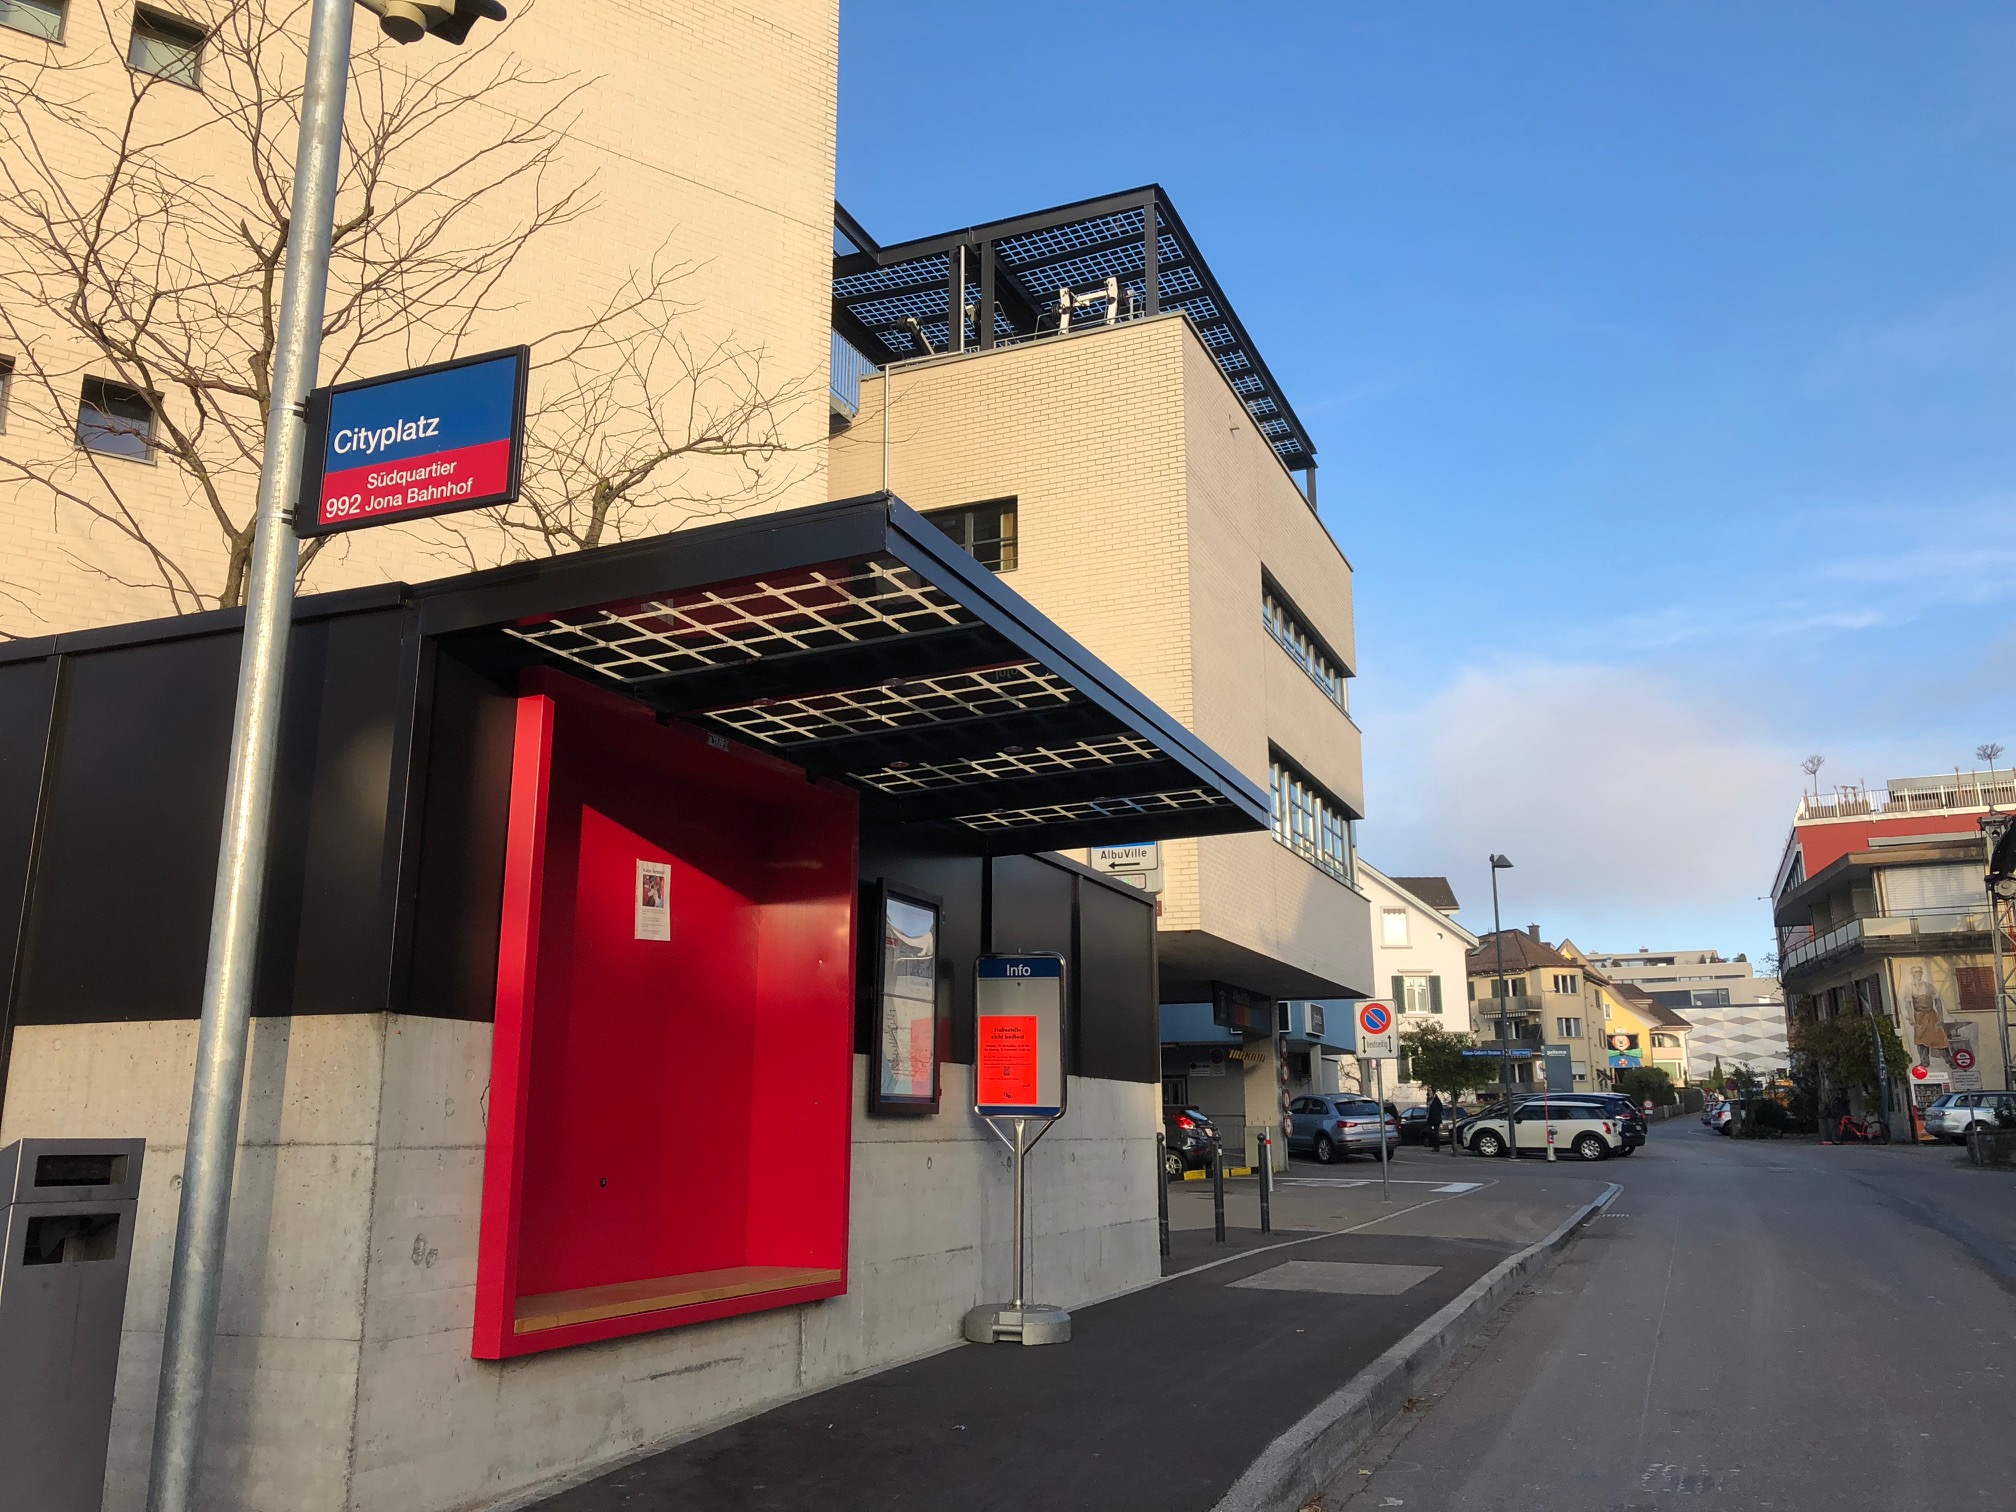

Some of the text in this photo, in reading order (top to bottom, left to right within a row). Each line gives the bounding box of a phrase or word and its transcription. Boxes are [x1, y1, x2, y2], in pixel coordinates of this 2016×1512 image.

[334, 416, 440, 454] Cityplatz
[367, 461, 458, 489] Südquartier
[325, 477, 474, 518] 992 Jona Bahnhof
[1100, 848, 1147, 860] AlbuVille
[1006, 964, 1031, 977] Info
[1366, 1040, 1388, 1049] beidseitig
